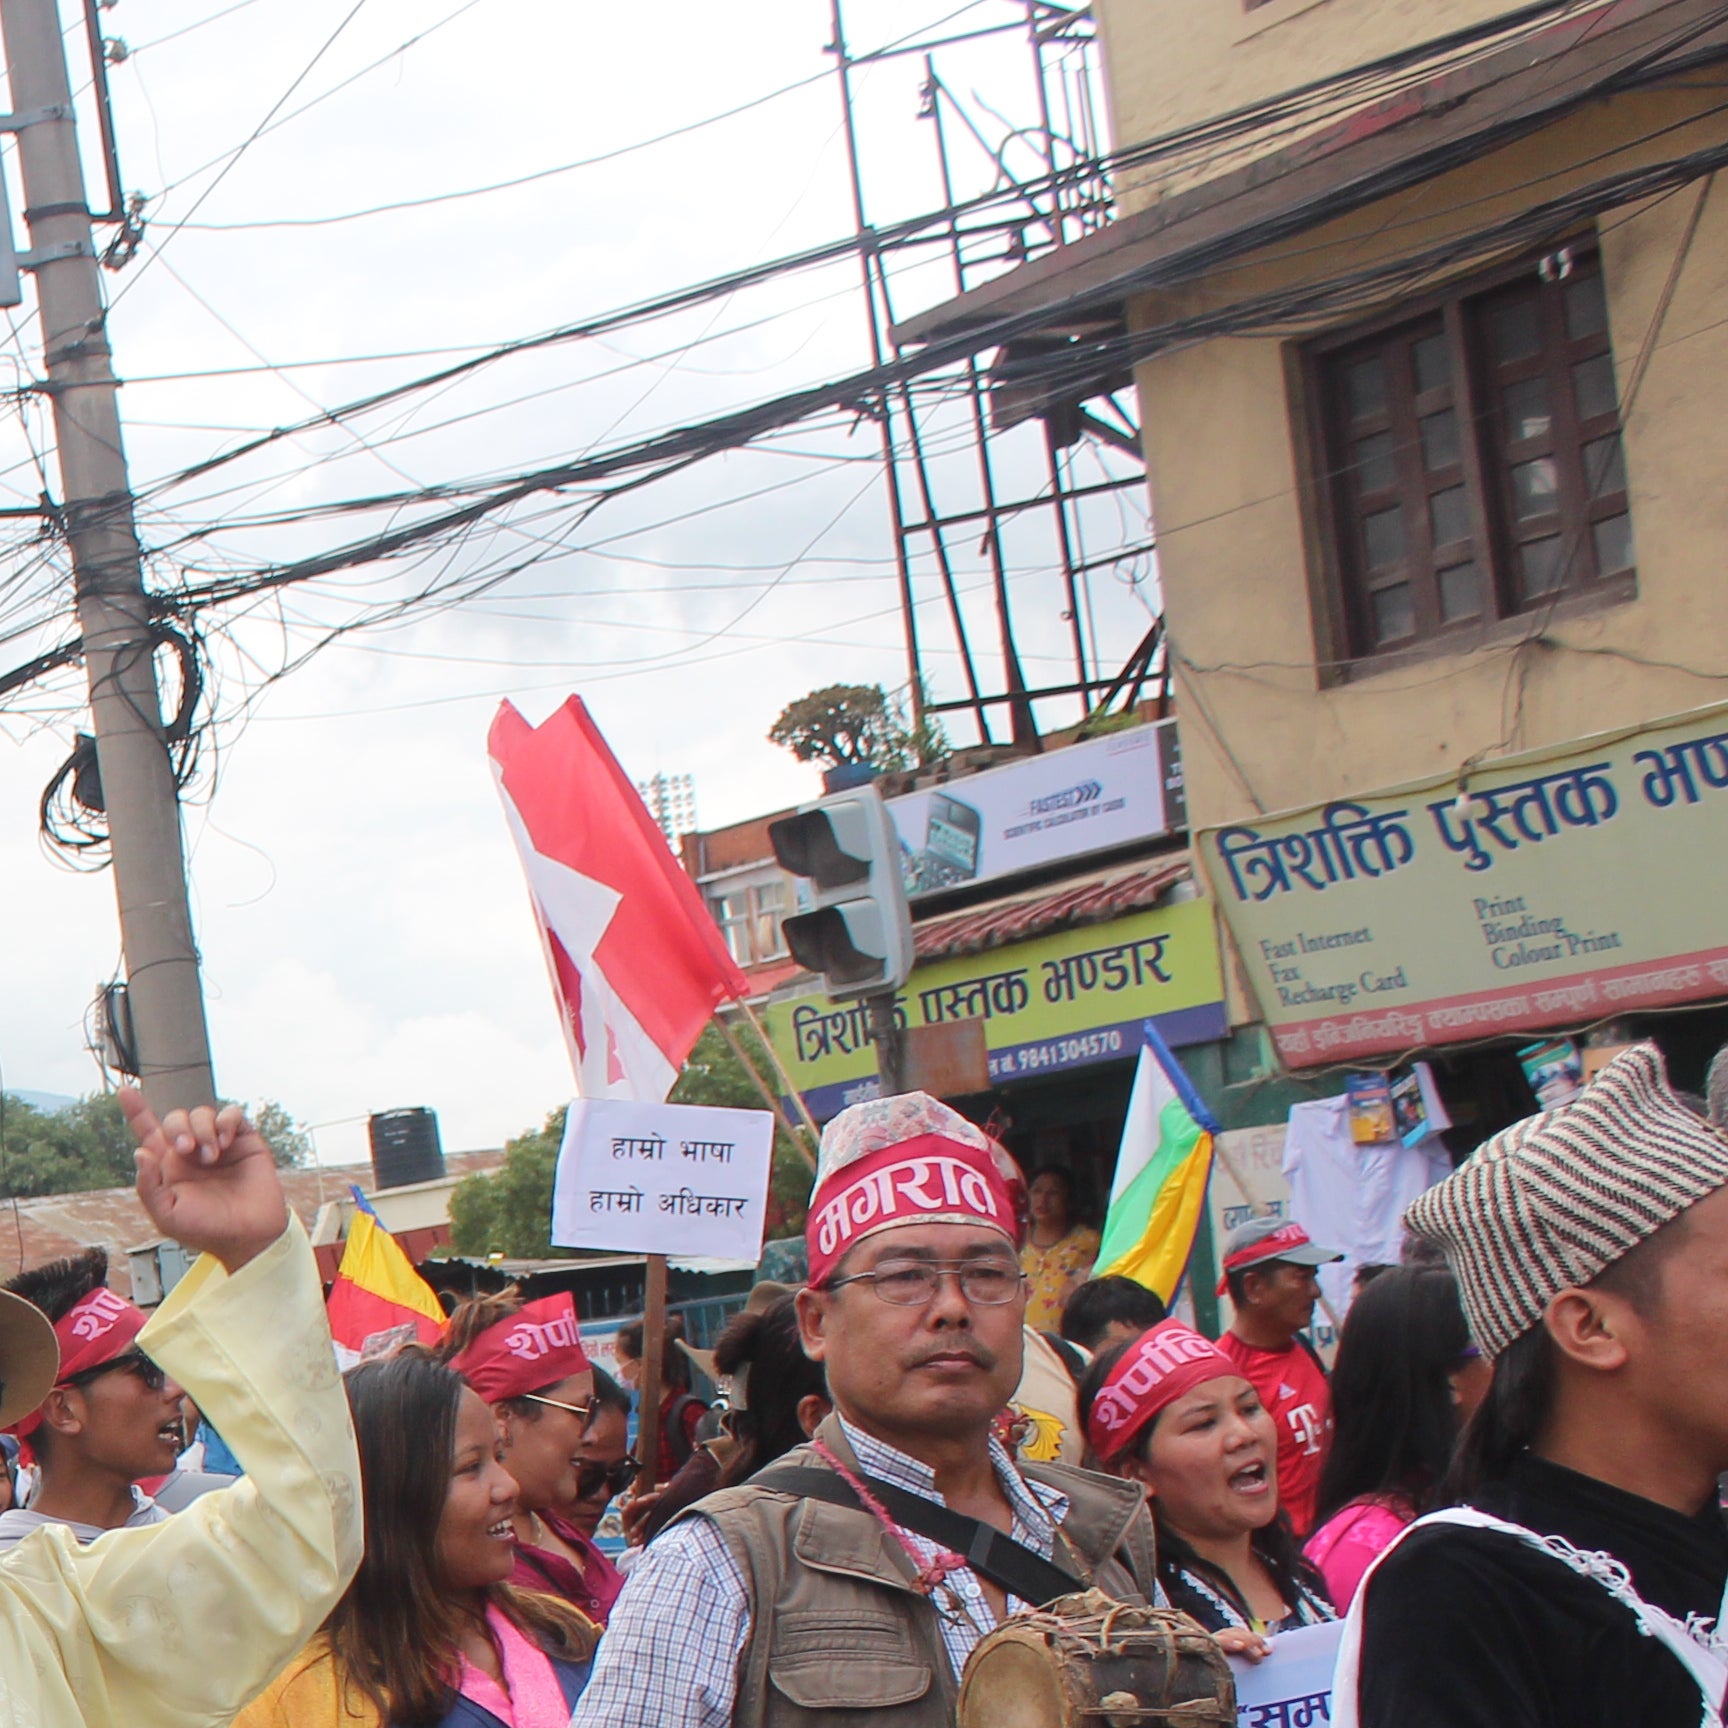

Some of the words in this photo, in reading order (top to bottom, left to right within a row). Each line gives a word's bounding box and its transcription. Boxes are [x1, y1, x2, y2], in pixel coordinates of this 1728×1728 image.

[1216, 800, 1417, 902] त्रिशक्ति
[1427, 762, 1619, 871] पुस्तक
[1474, 896, 1527, 920] Print
[1259, 936, 1296, 961] Fast
[1299, 926, 1374, 955] Internet
[1482, 913, 1565, 947] Binding
[1042, 933, 1174, 1004] भण्डार
[1491, 942, 1562, 970] Colour
[1563, 929, 1623, 957] Print
[1269, 961, 1301, 985] Fax
[1278, 976, 1358, 1008] Recharge
[1359, 966, 1409, 995] Card
[1017, 1029, 1122, 1071] 9841304570
[611, 1131, 668, 1162] हाम्रो
[680, 1137, 736, 1164] भाषा
[589, 1184, 646, 1215] हाम्रो
[657, 1187, 749, 1220] अधिकार
[814, 1155, 998, 1256] मगरात
